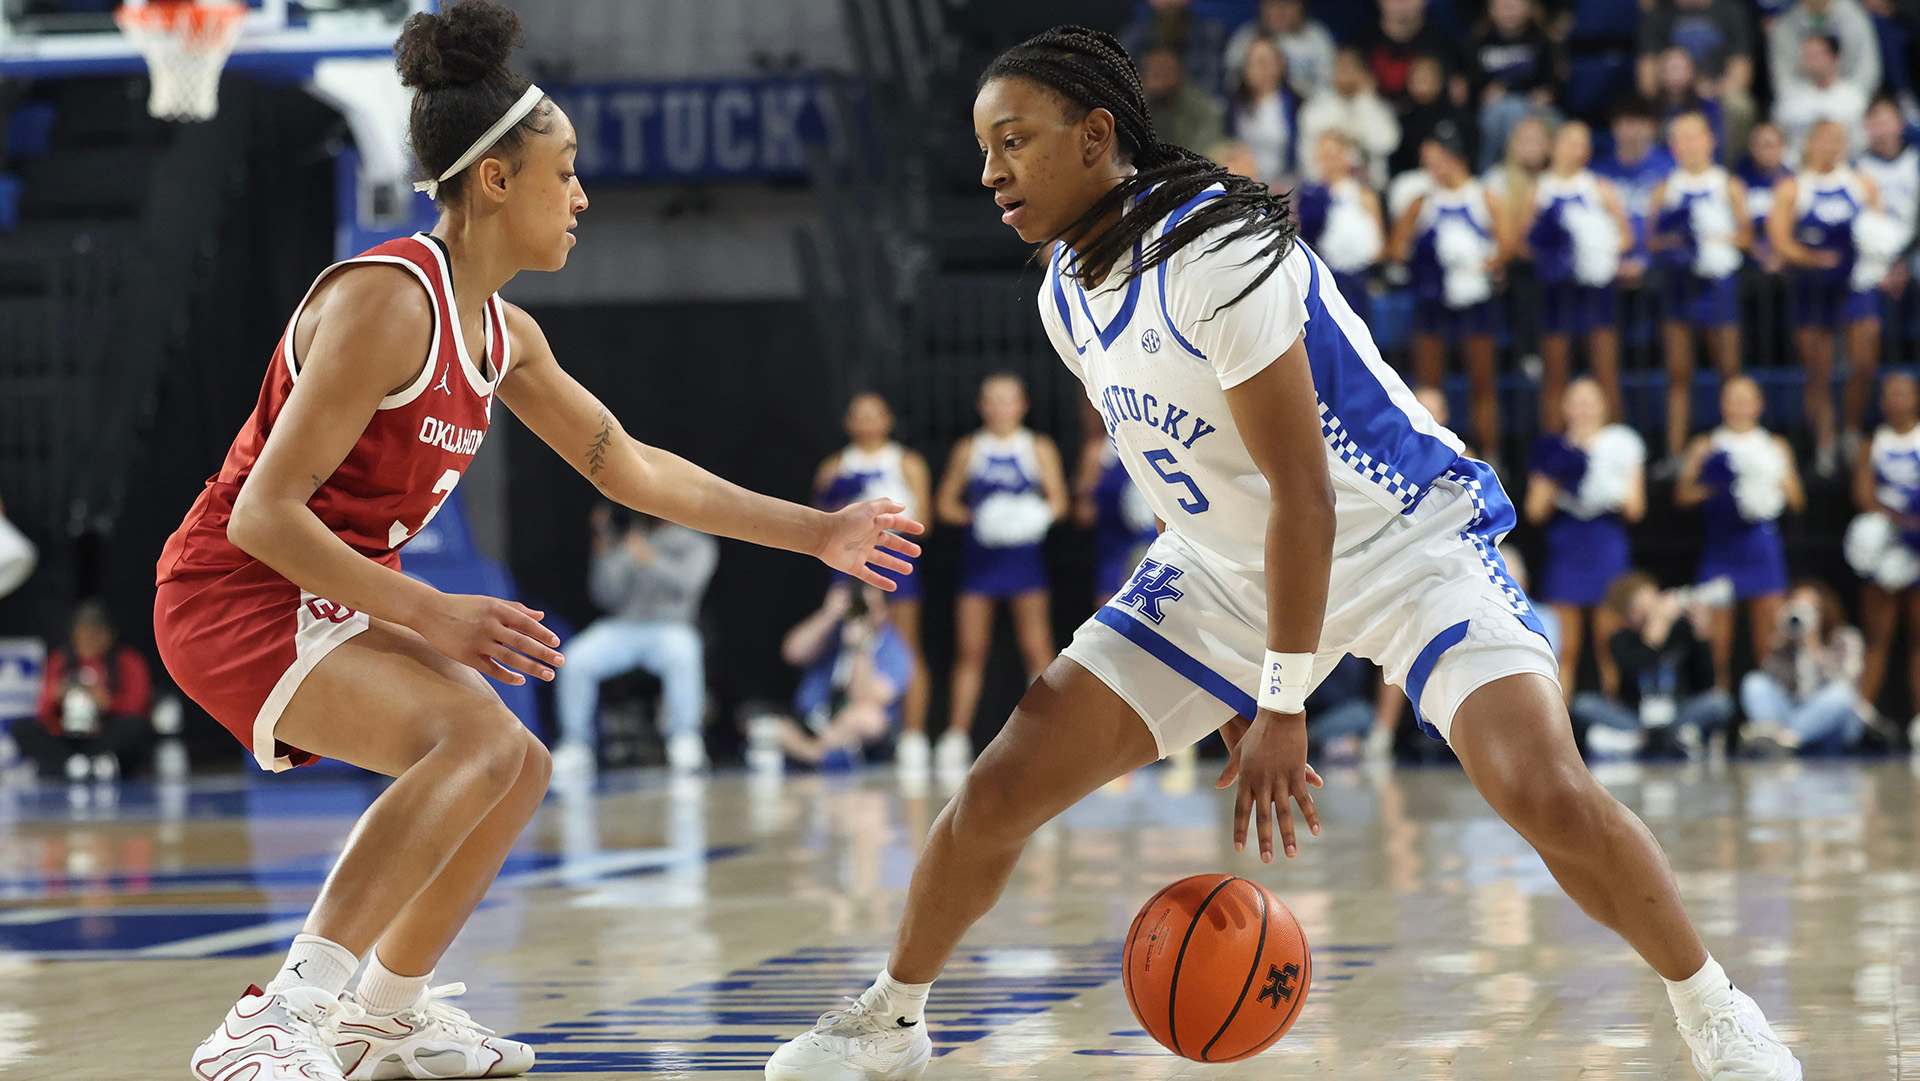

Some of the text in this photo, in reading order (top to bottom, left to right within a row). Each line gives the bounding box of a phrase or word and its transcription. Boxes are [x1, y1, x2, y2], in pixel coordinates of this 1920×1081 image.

[1142, 328, 1161, 353] SEC
[418, 416, 487, 455] OKLAHOM
[1101, 385, 1216, 452] ENTUCKY
[388, 468, 461, 549] 3
[1142, 448, 1210, 515] 5
